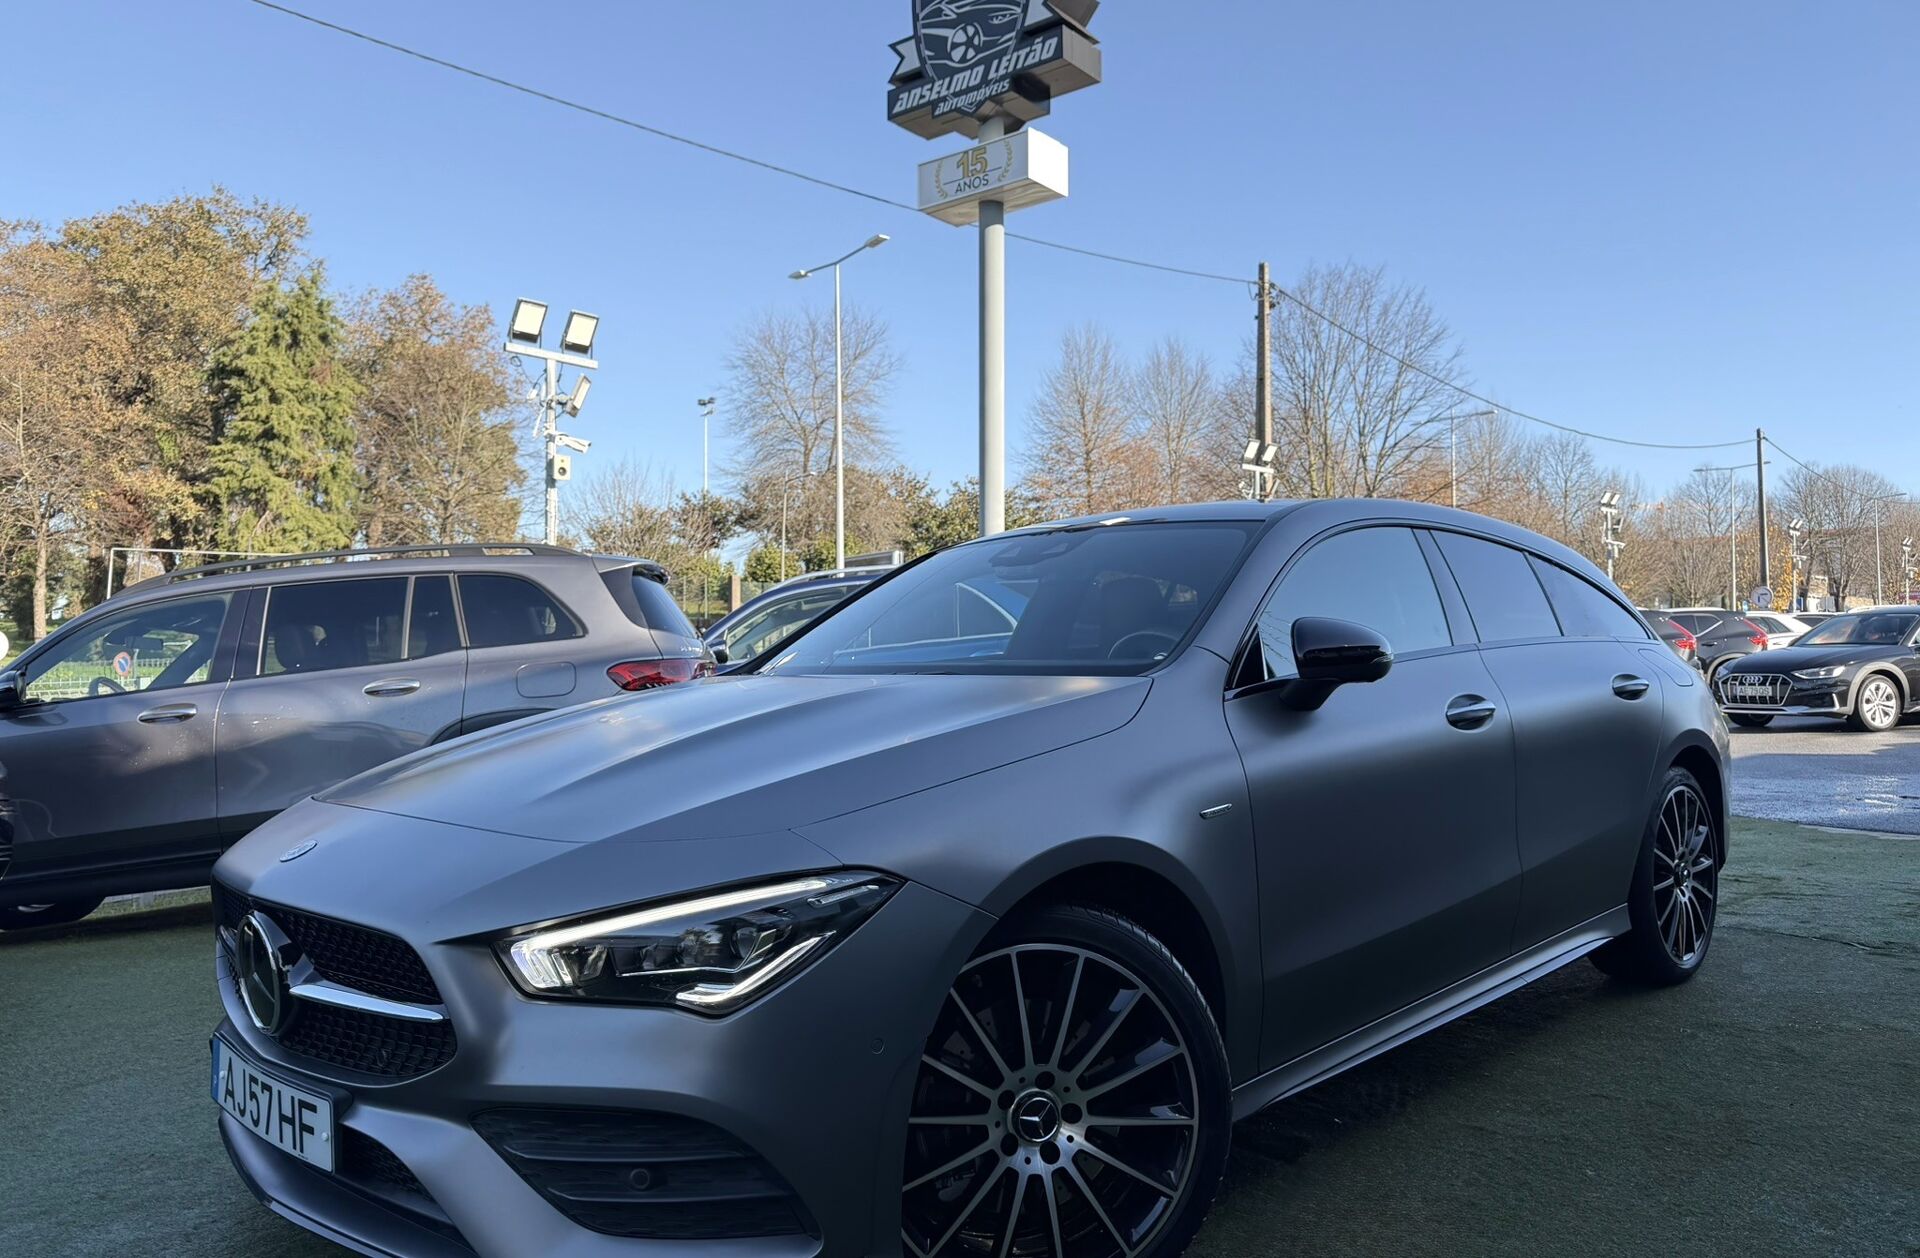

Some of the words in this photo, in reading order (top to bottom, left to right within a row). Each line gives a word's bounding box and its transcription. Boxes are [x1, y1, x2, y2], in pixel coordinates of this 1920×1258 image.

[988, 36, 1059, 80] LEITÃO
[956, 146, 988, 178] 15
[955, 173, 989, 194] ANOS
[224, 1056, 318, 1154] AJ57HF
